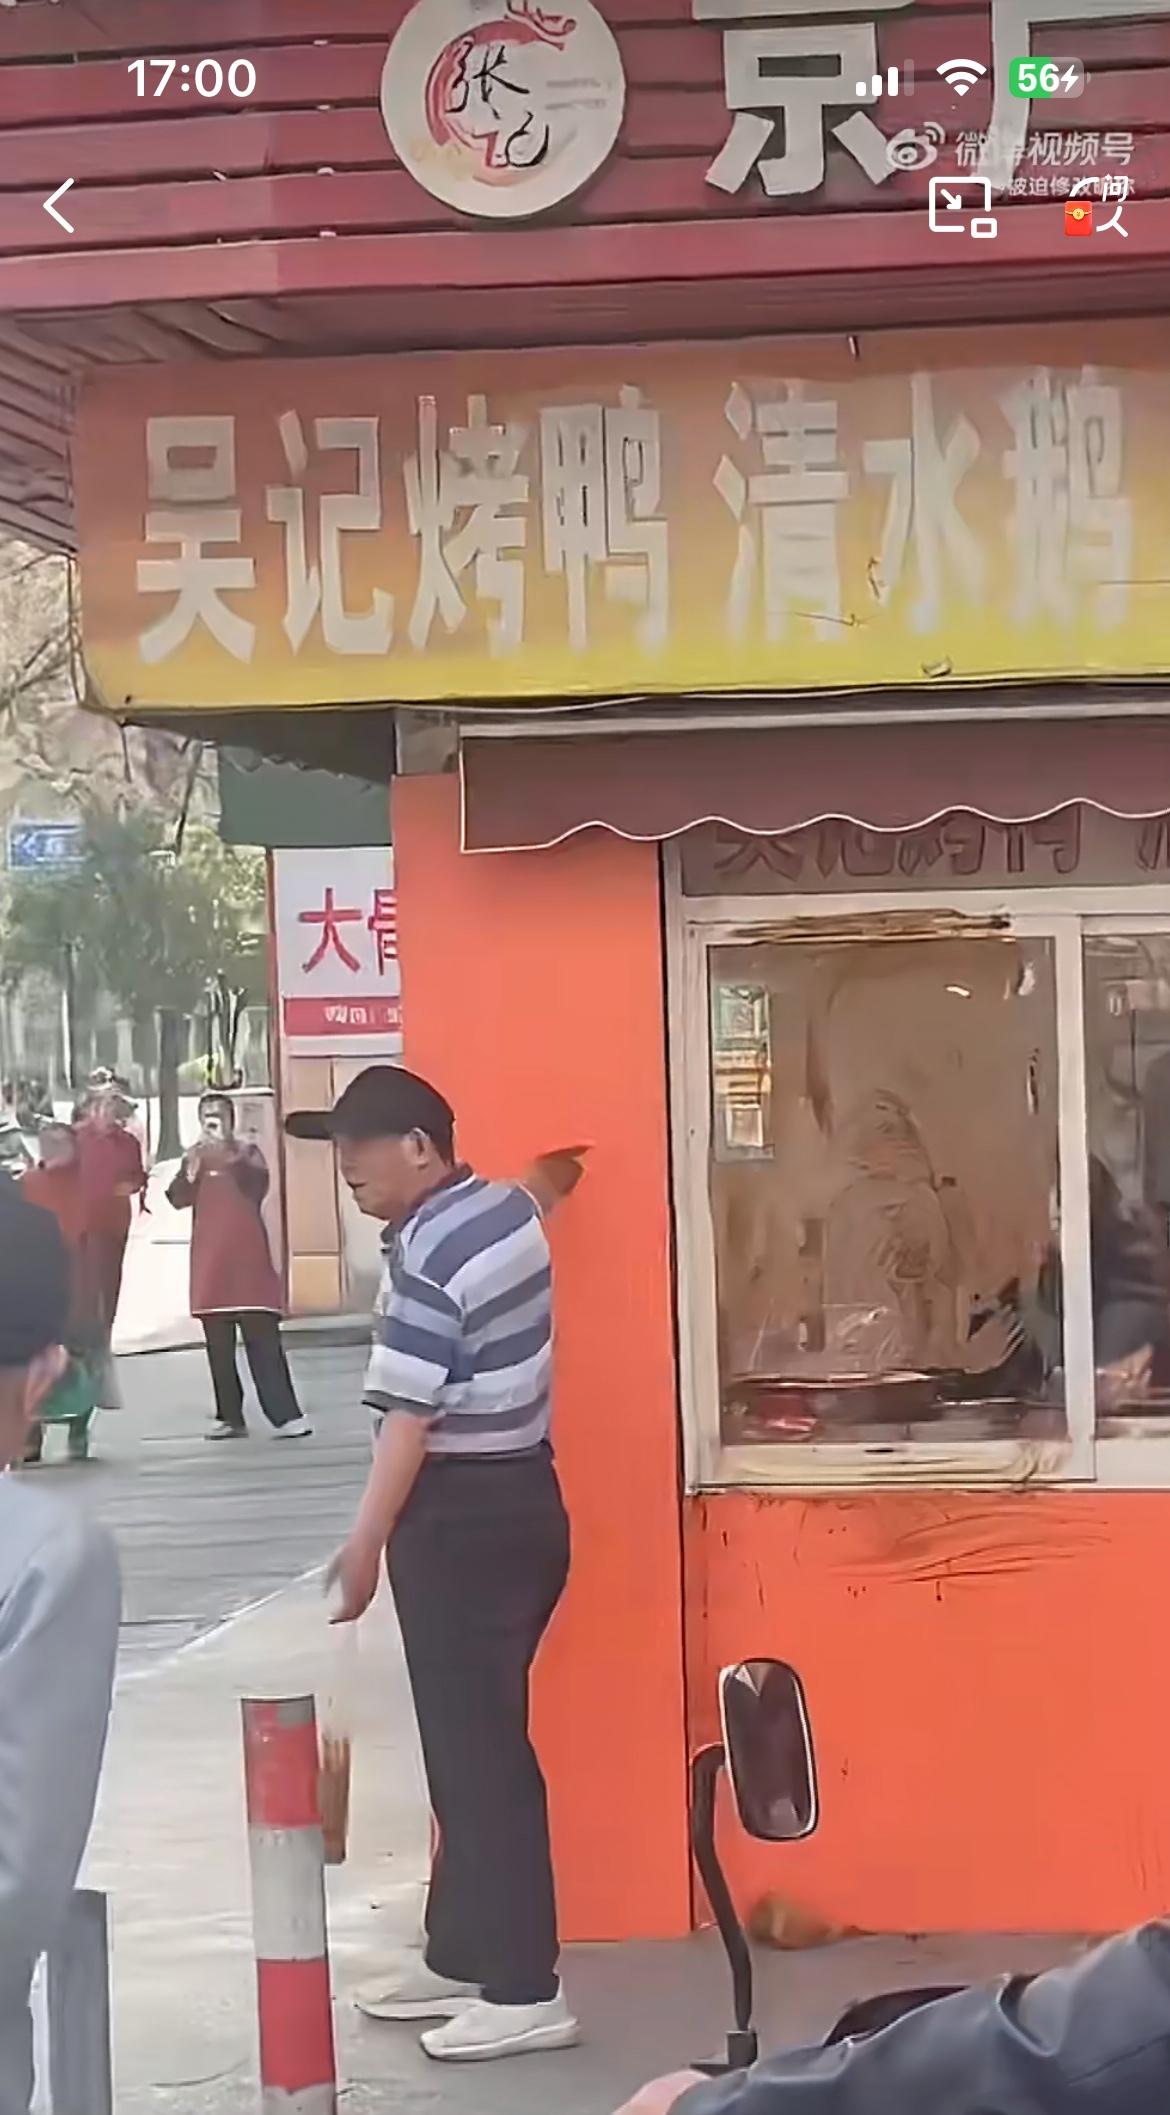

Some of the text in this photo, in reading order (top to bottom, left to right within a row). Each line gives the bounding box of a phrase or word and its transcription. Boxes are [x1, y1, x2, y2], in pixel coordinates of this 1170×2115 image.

[136, 364, 1133, 664] 吴记烤鸭 清水鹅
